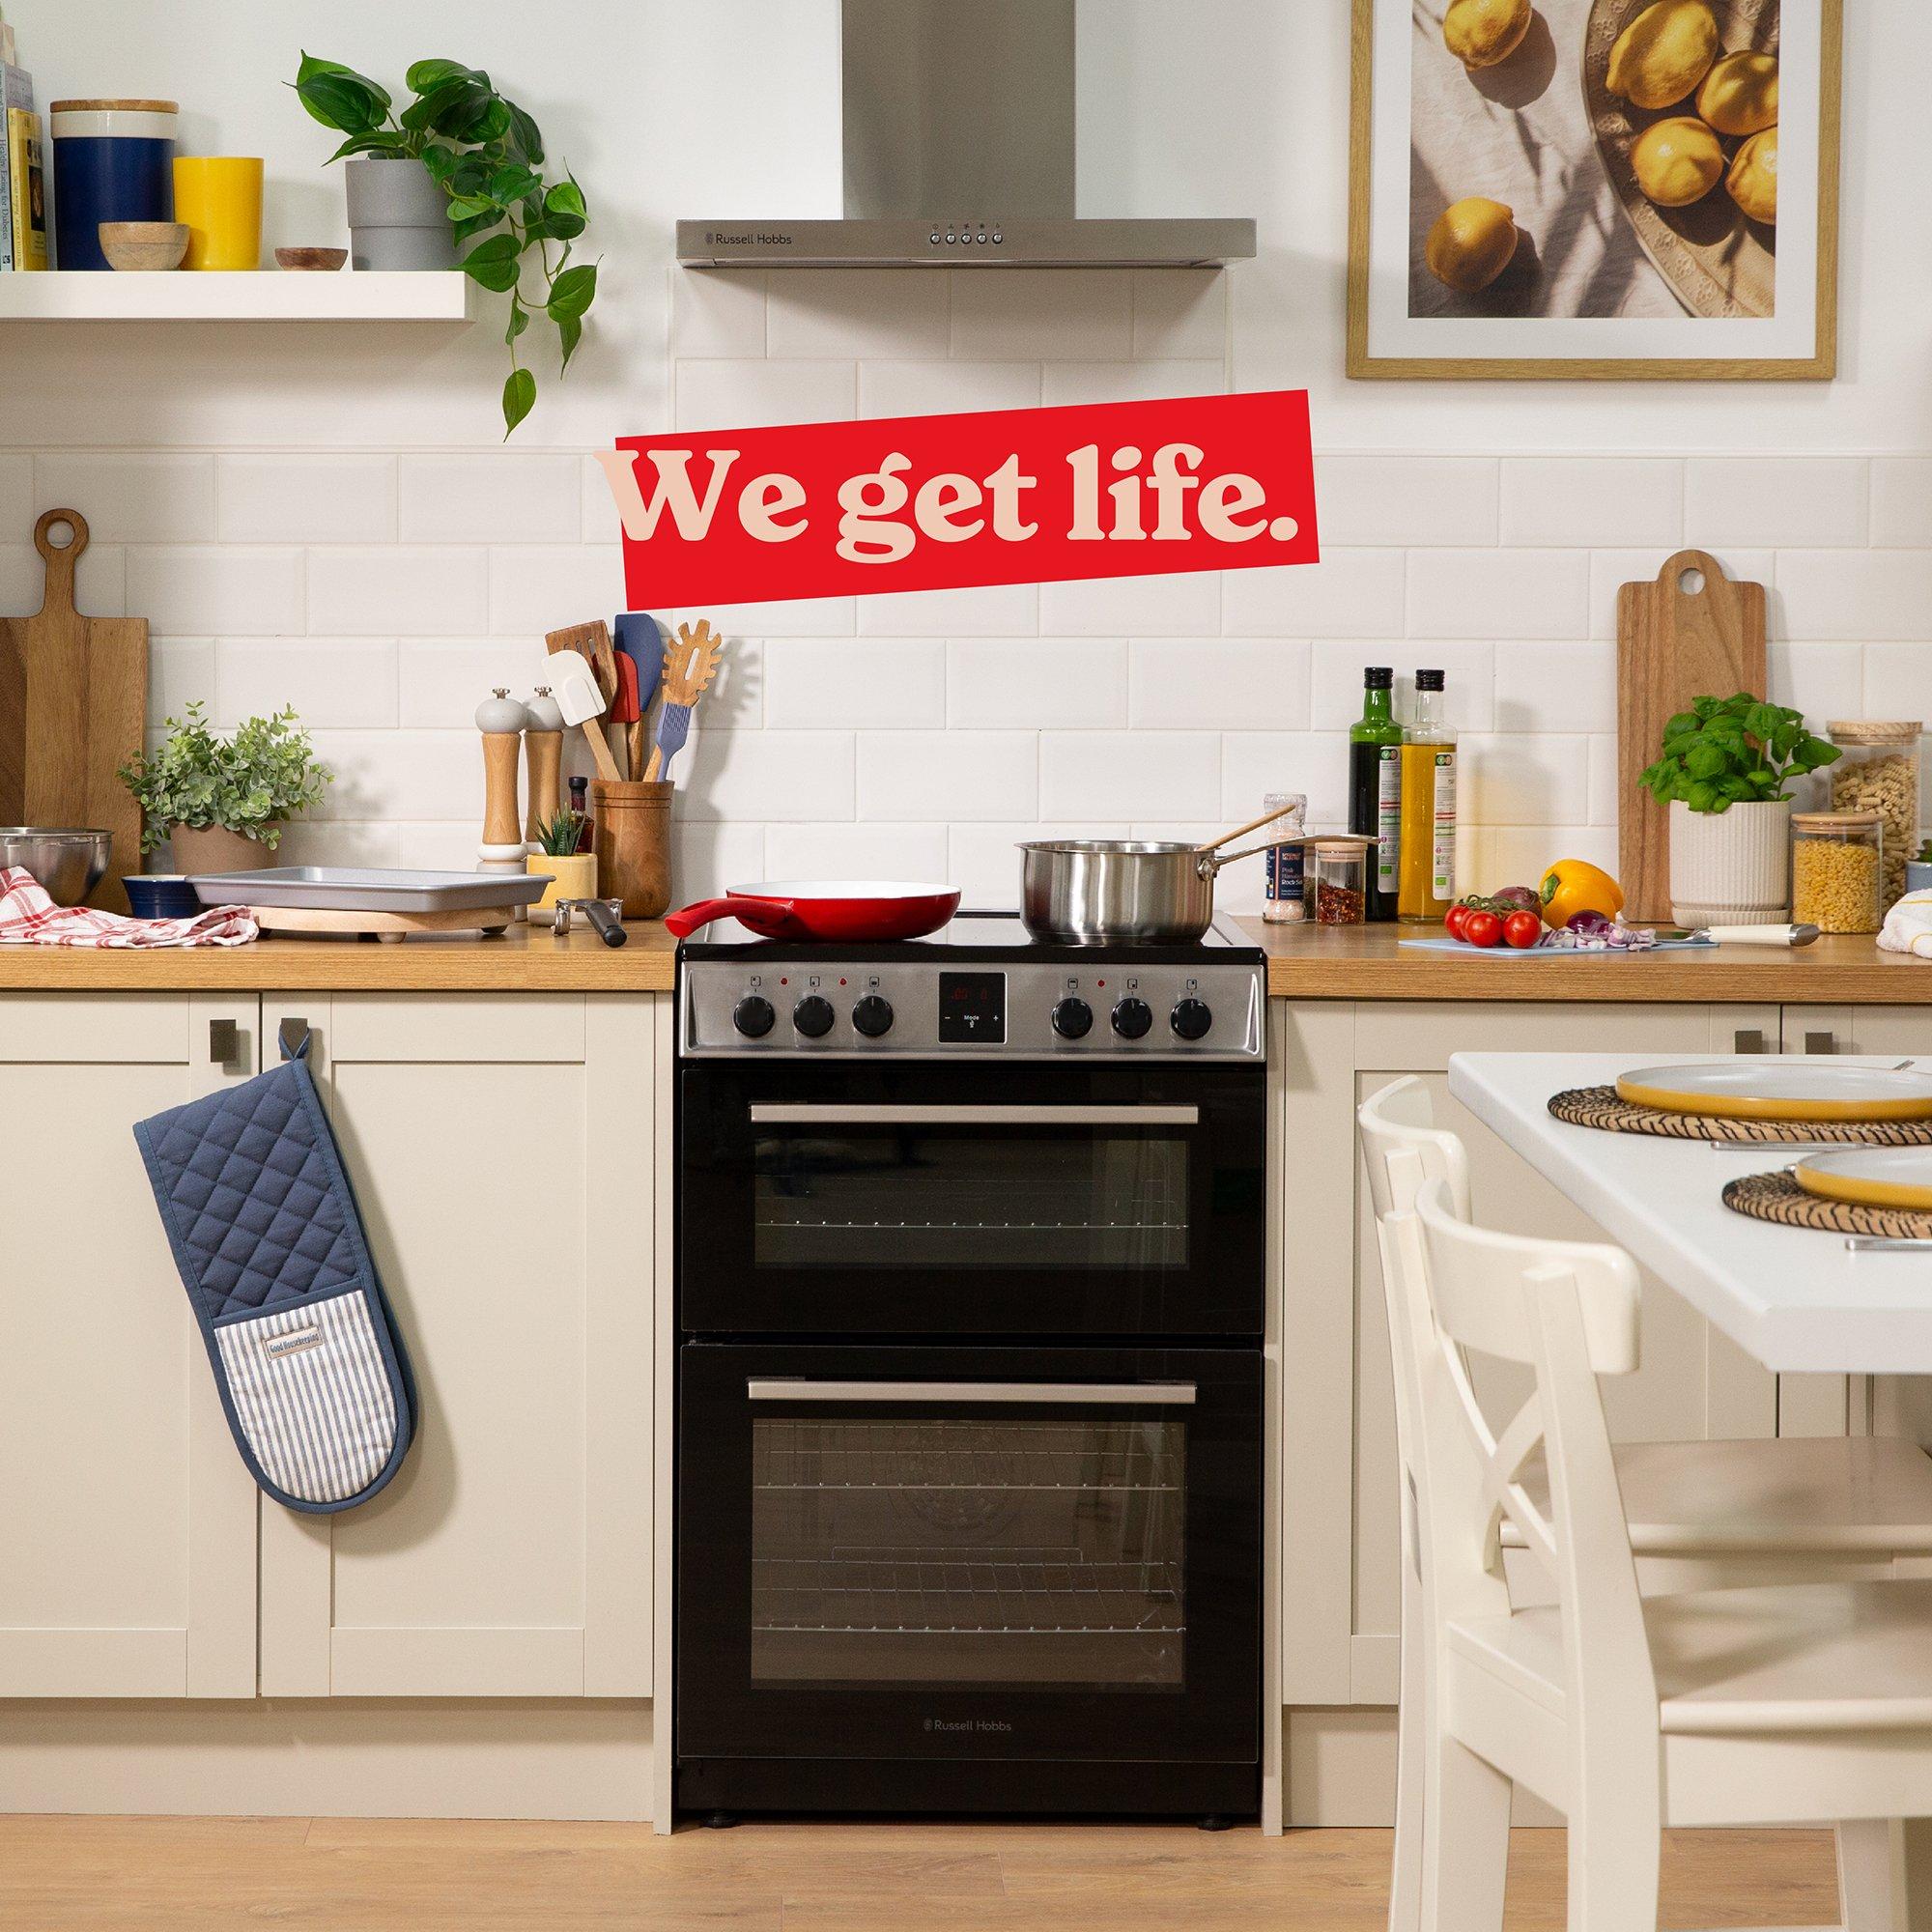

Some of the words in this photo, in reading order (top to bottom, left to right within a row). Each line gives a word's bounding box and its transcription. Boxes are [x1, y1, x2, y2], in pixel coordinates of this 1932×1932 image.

[716, 234, 753, 244] Russell
[757, 234, 792, 244] Hobbs
[270, 1342, 283, 1353] Good
[283, 1333, 320, 1350] Housekeeping
[934, 1719, 973, 1731] Russell
[976, 1720, 1012, 1731] Hobbs
